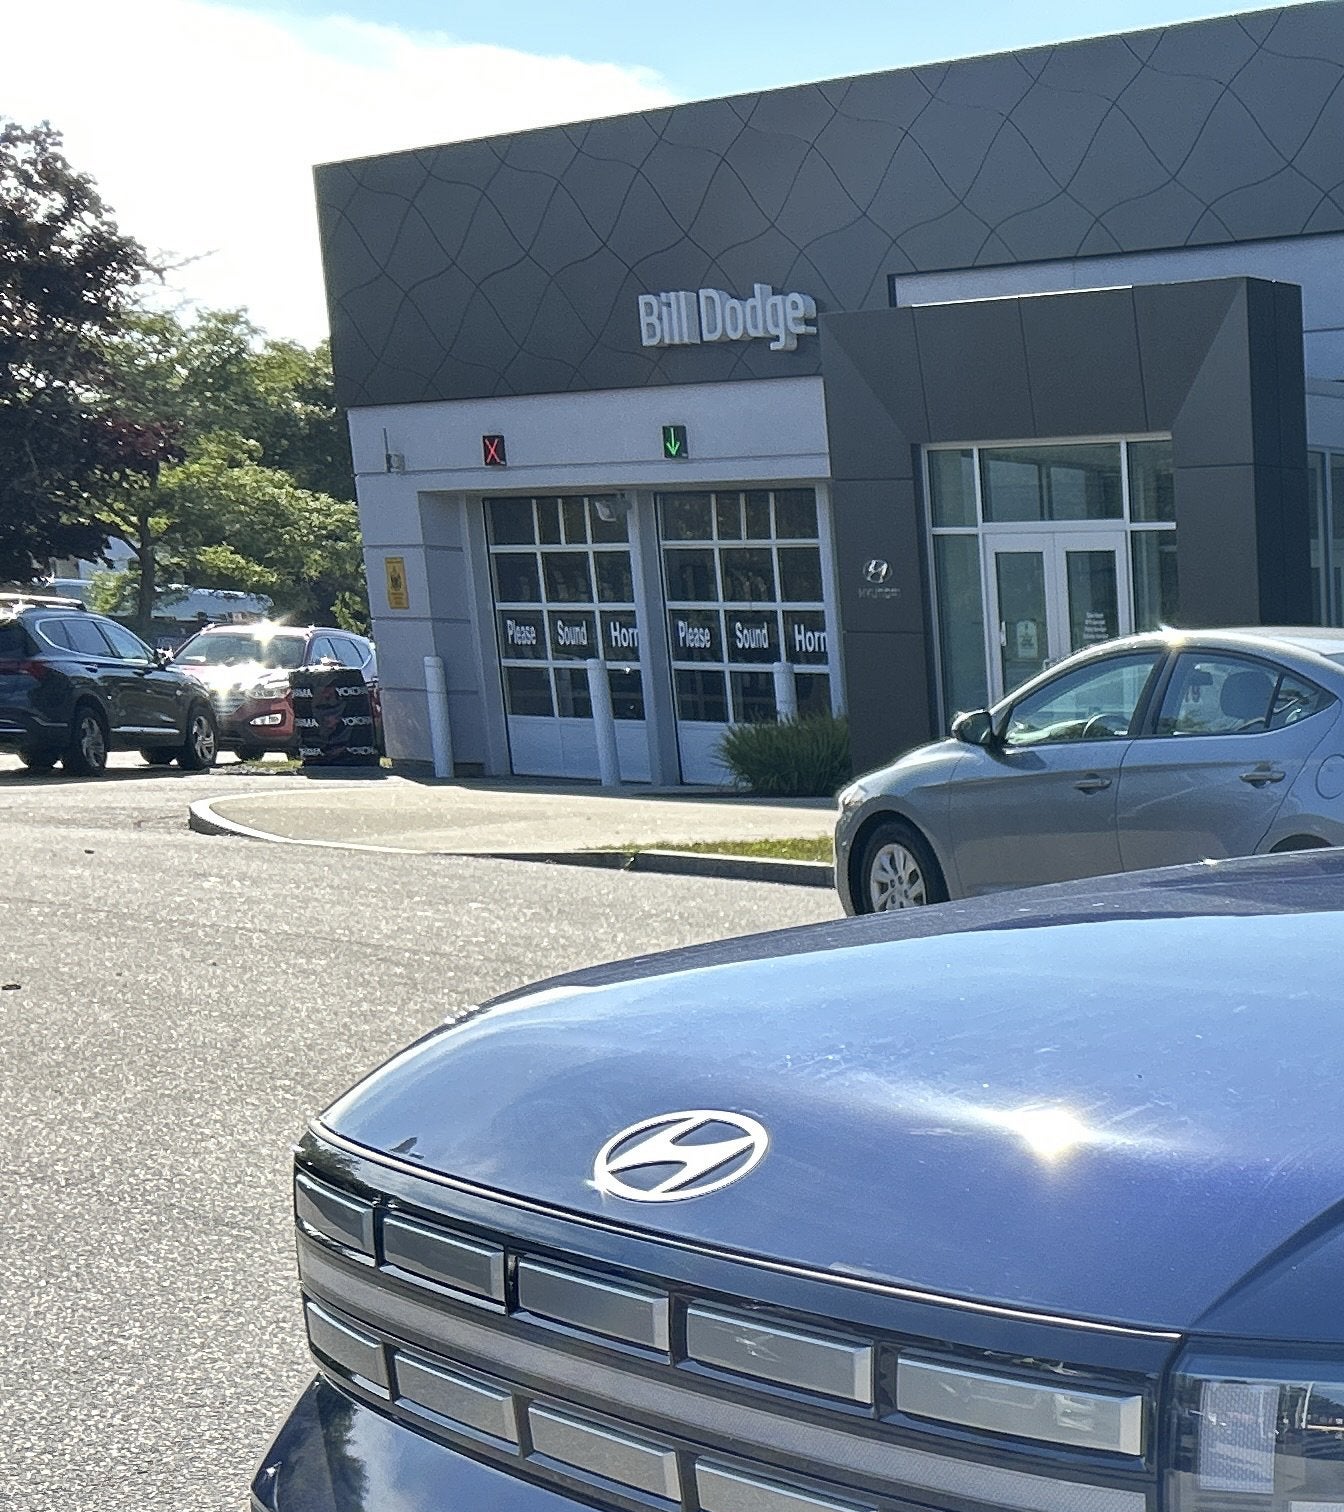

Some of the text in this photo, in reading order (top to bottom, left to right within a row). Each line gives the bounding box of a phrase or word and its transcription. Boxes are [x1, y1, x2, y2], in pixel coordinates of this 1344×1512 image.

[638, 283, 816, 351] Bill Dodge
[506, 619, 537, 645] Please
[557, 619, 588, 646] Sound
[678, 620, 828, 652] Please Sound Horn
